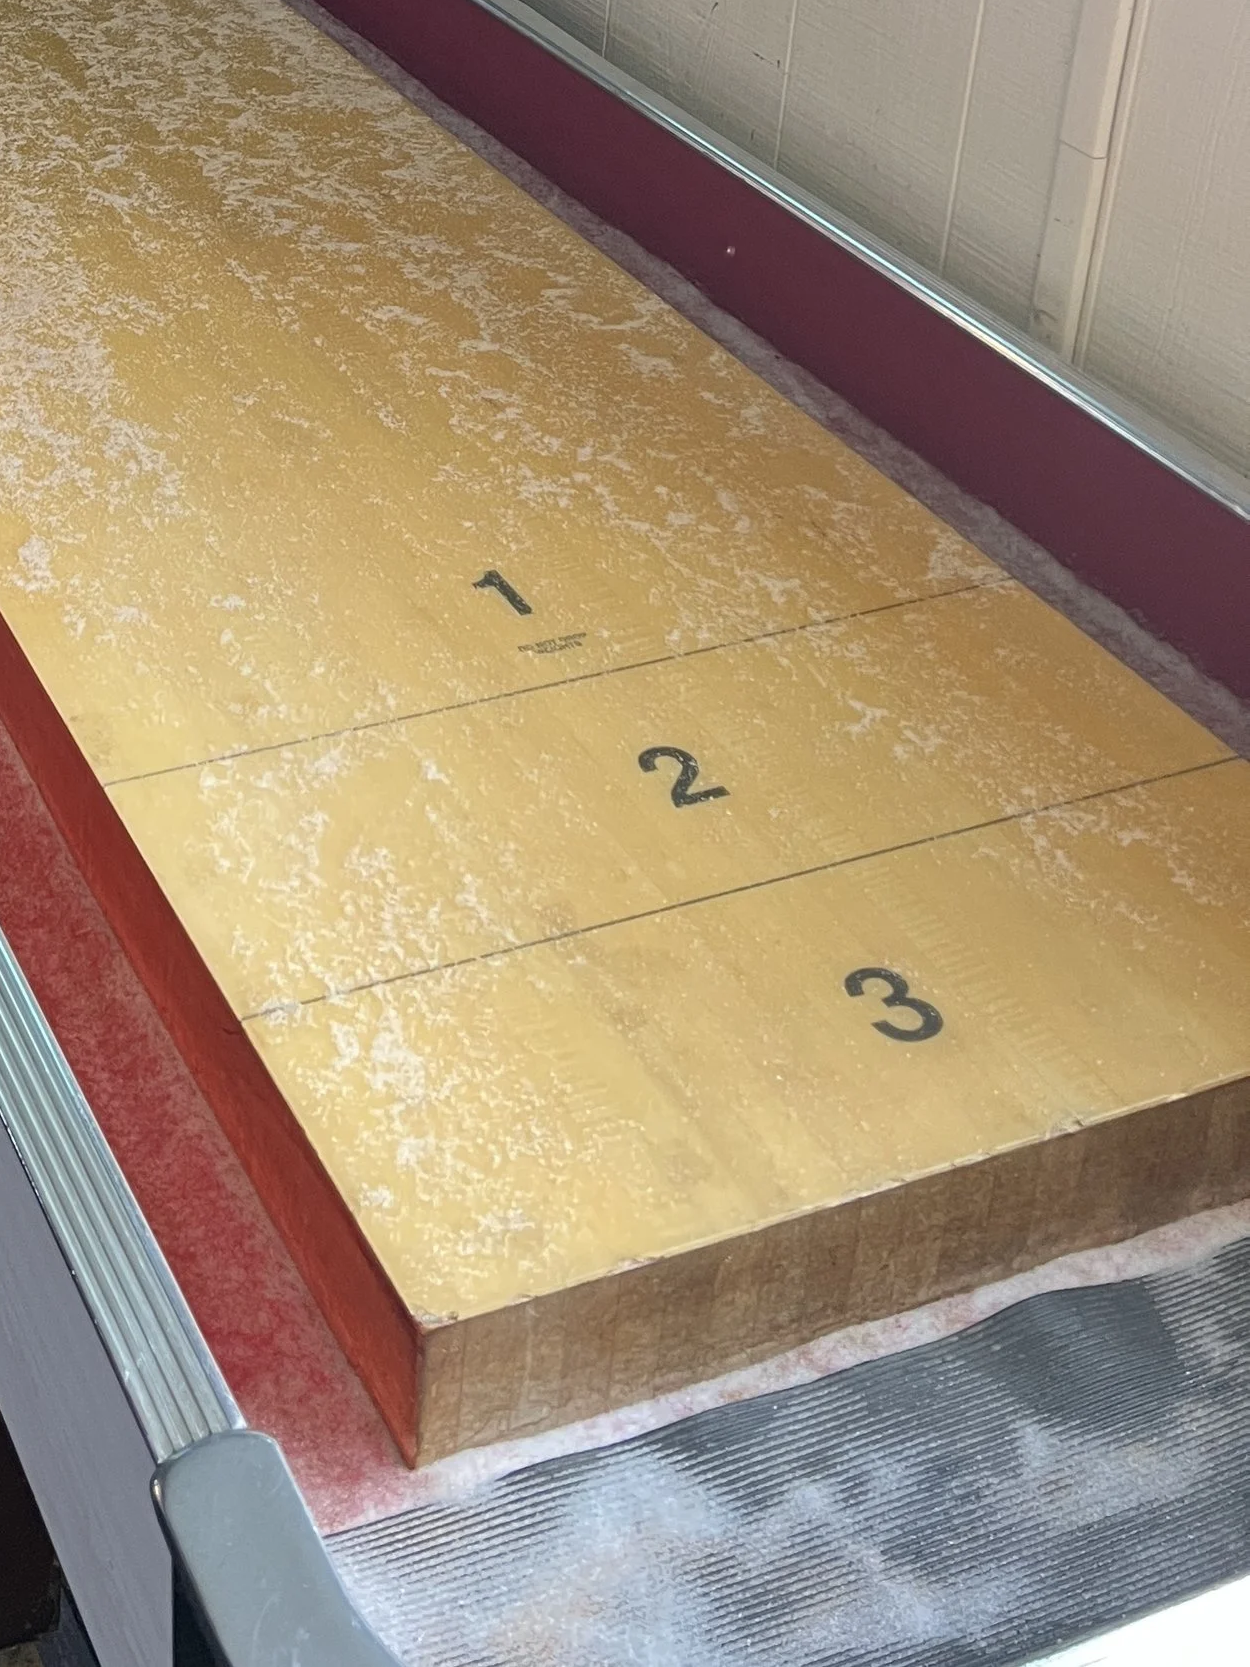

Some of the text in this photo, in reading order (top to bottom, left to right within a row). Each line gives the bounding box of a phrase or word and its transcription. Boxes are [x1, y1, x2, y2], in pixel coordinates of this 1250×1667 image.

[472, 569, 533, 616] 1
[637, 745, 731, 808] 2
[843, 966, 945, 1043] 3
